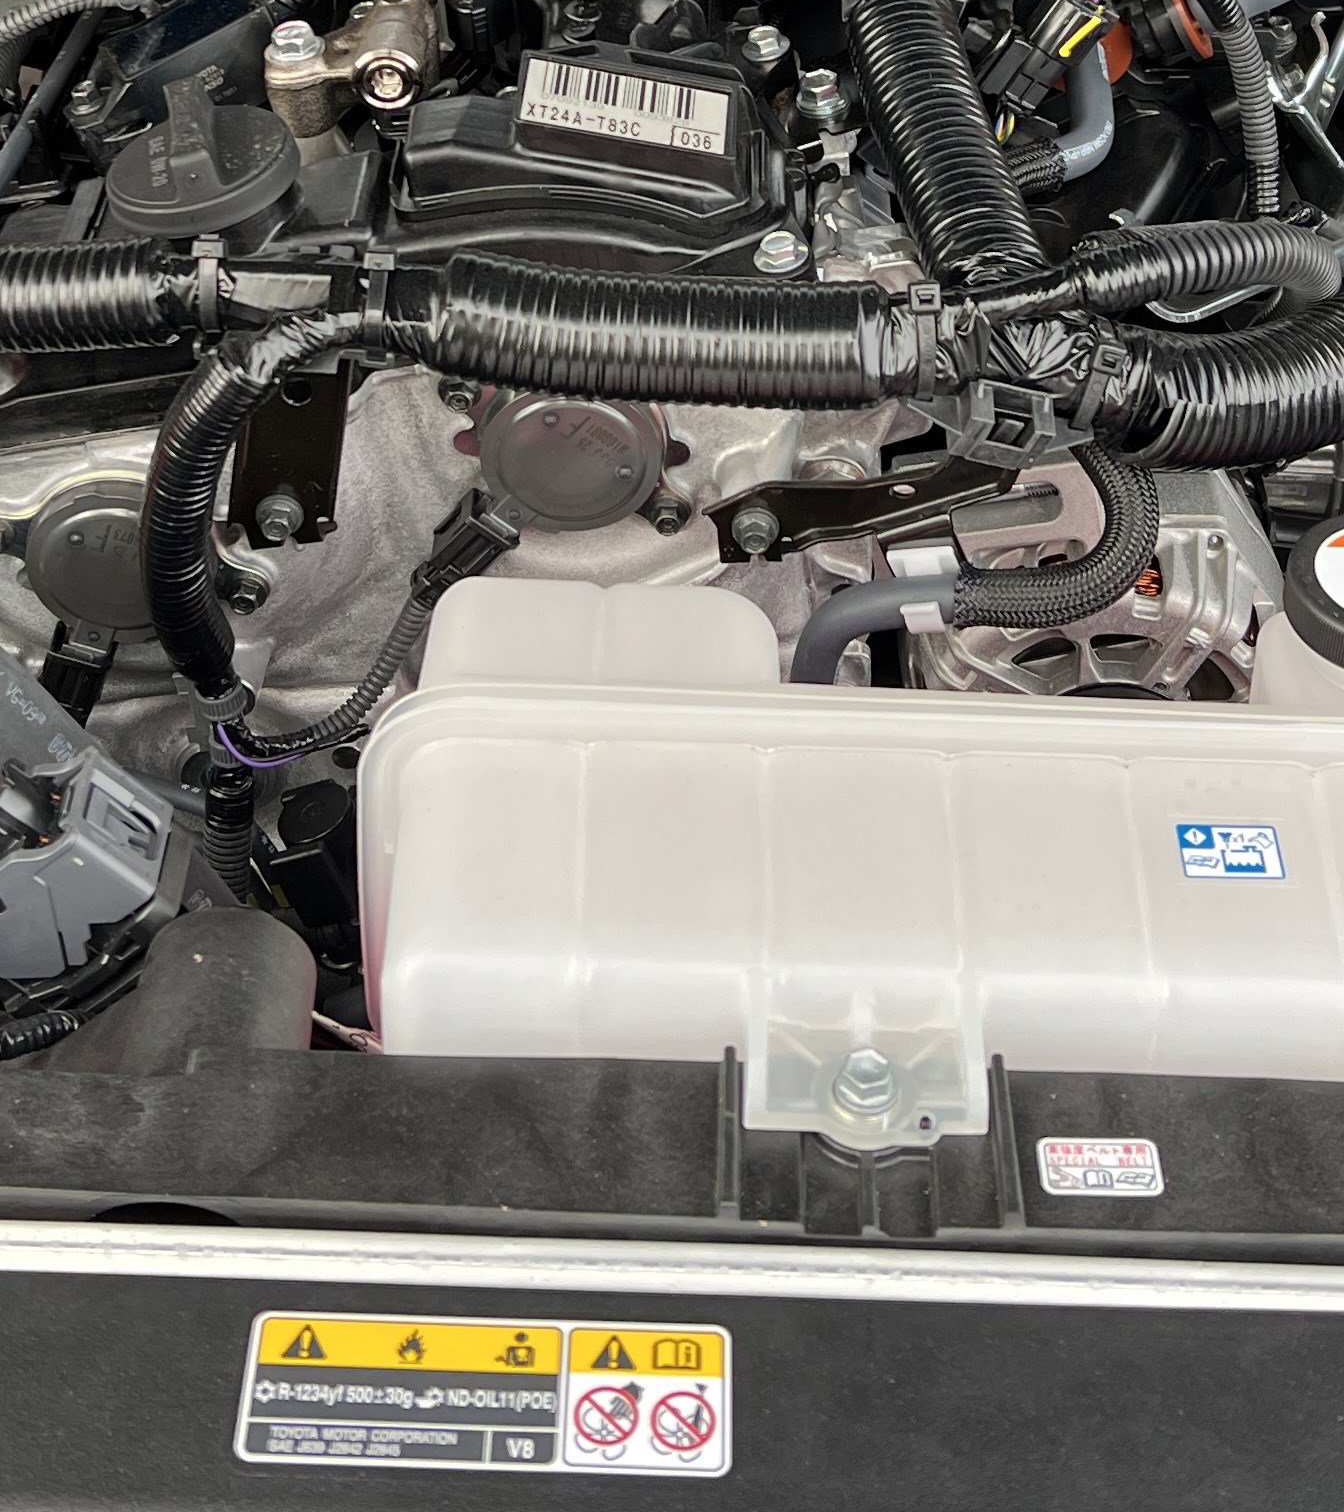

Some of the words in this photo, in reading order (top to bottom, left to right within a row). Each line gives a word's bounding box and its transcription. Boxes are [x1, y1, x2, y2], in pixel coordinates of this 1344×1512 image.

[526, 103, 641, 137] XT24A-T83C
[277, 1380, 345, 1406] R-1234yf
[346, 1384, 414, 1410] 500±30g
[445, 1387, 558, 1413] ND-OIL11(POE)
[270, 1424, 319, 1442] TOYOTA
[322, 1427, 368, 1443] MOTOR
[370, 1428, 459, 1447] CORPORATION
